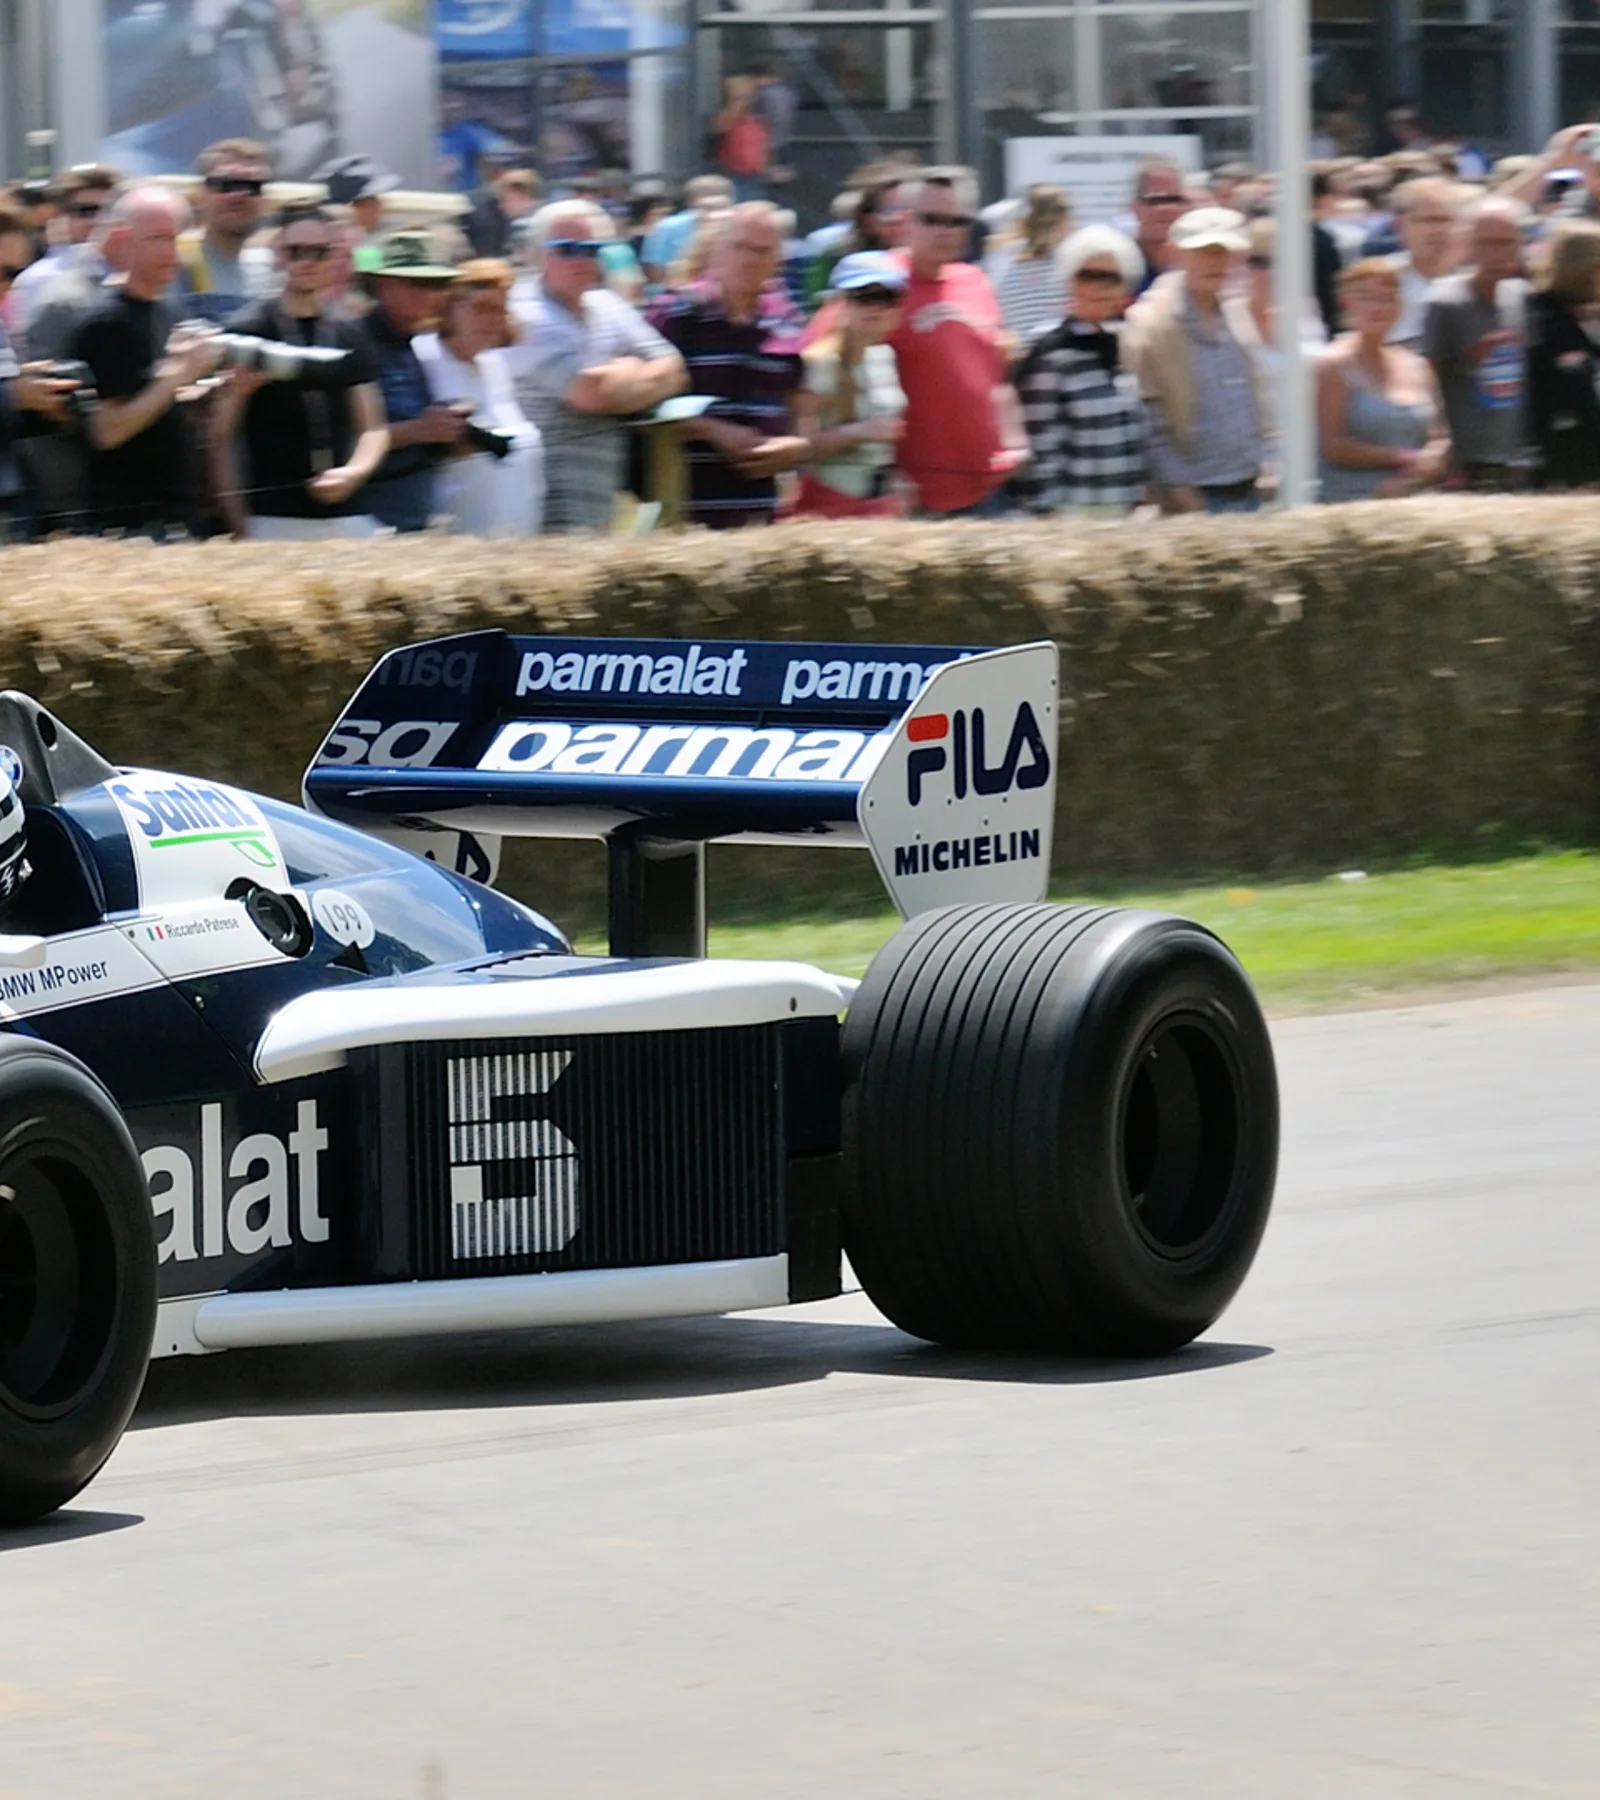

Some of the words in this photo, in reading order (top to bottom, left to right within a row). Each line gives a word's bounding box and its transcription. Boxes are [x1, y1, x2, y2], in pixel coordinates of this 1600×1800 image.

[515, 645, 747, 697] parmalat
[907, 702, 1050, 807] FILA
[895, 829, 1040, 876] MICHELIN
[164, 920, 206, 939] Riccardo
[203, 917, 240, 932] Patrese
[321, 903, 363, 933] 199
[38, 961, 108, 991] MPower
[446, 1050, 581, 1260] 5
